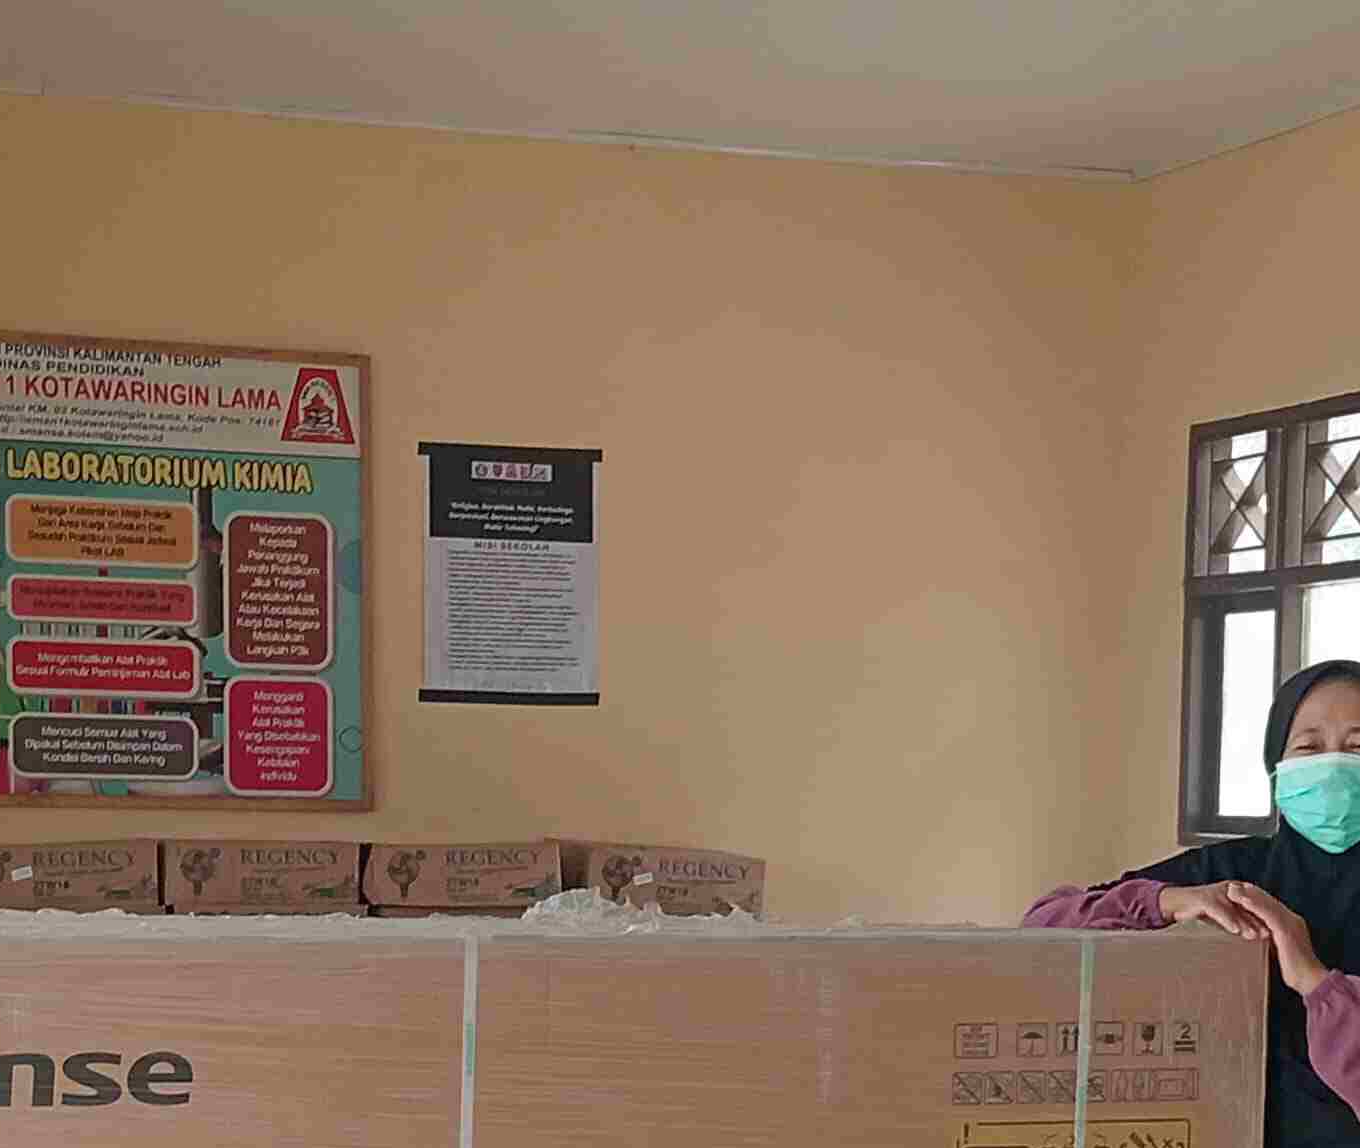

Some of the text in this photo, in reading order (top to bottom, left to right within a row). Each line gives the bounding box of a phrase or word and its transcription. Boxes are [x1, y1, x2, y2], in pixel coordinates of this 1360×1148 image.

[5, 343, 71, 359] PROVINSI
[73, 347, 161, 365] KALIMANTAN
[167, 353, 223, 368] TENGAH
[46, 361, 144, 376] PENDIDIKAN
[6, 375, 15, 395] 1
[25, 375, 209, 407] KOTAWARINGIN
[218, 387, 282, 411] LAMA
[6, 448, 229, 490] LABORATORIUM
[233, 459, 315, 495] KIMIA
[41, 725, 167, 741] Mencuci Semua Alat Yang
[112, 754, 133, 764] Dan
[134, 754, 167, 767] Kering
[32, 850, 137, 866] REGENCY
[240, 849, 338, 866] REGENCY
[445, 849, 541, 865] REGENCY
[657, 862, 750, 880] REGENCY
[1181, 1023, 1192, 1039] 2
